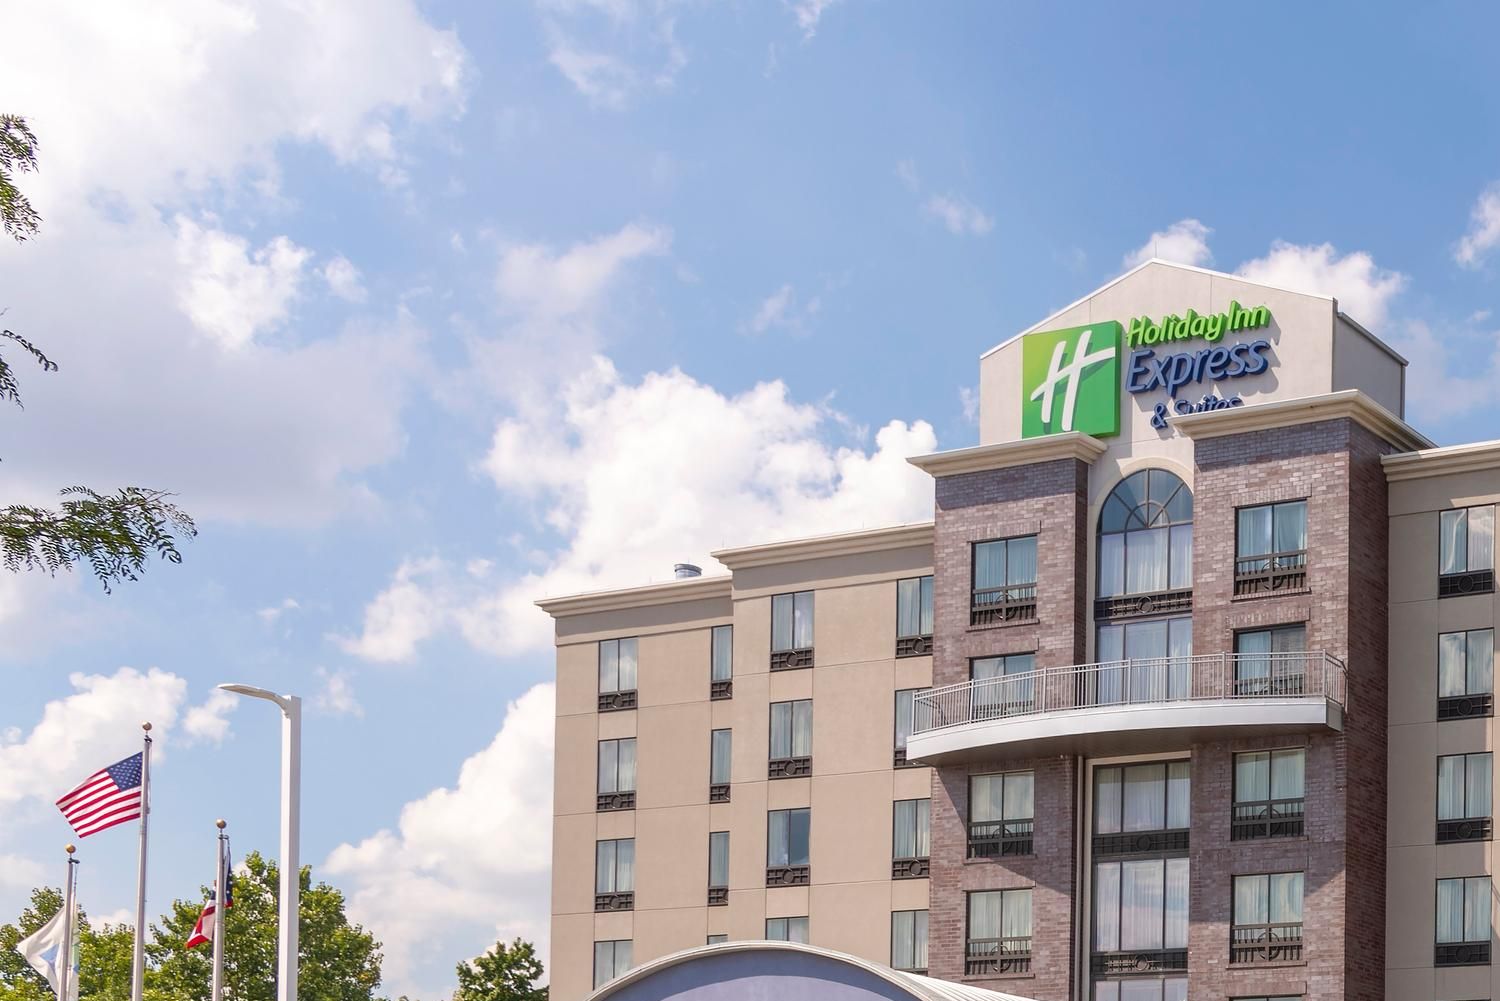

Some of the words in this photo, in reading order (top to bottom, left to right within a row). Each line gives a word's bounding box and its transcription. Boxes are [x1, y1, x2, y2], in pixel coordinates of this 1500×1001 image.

[1126, 308, 1228, 348] Holiday
[1227, 300, 1270, 331] Inn
[1126, 340, 1271, 397] Express
[1150, 402, 1168, 429] &
